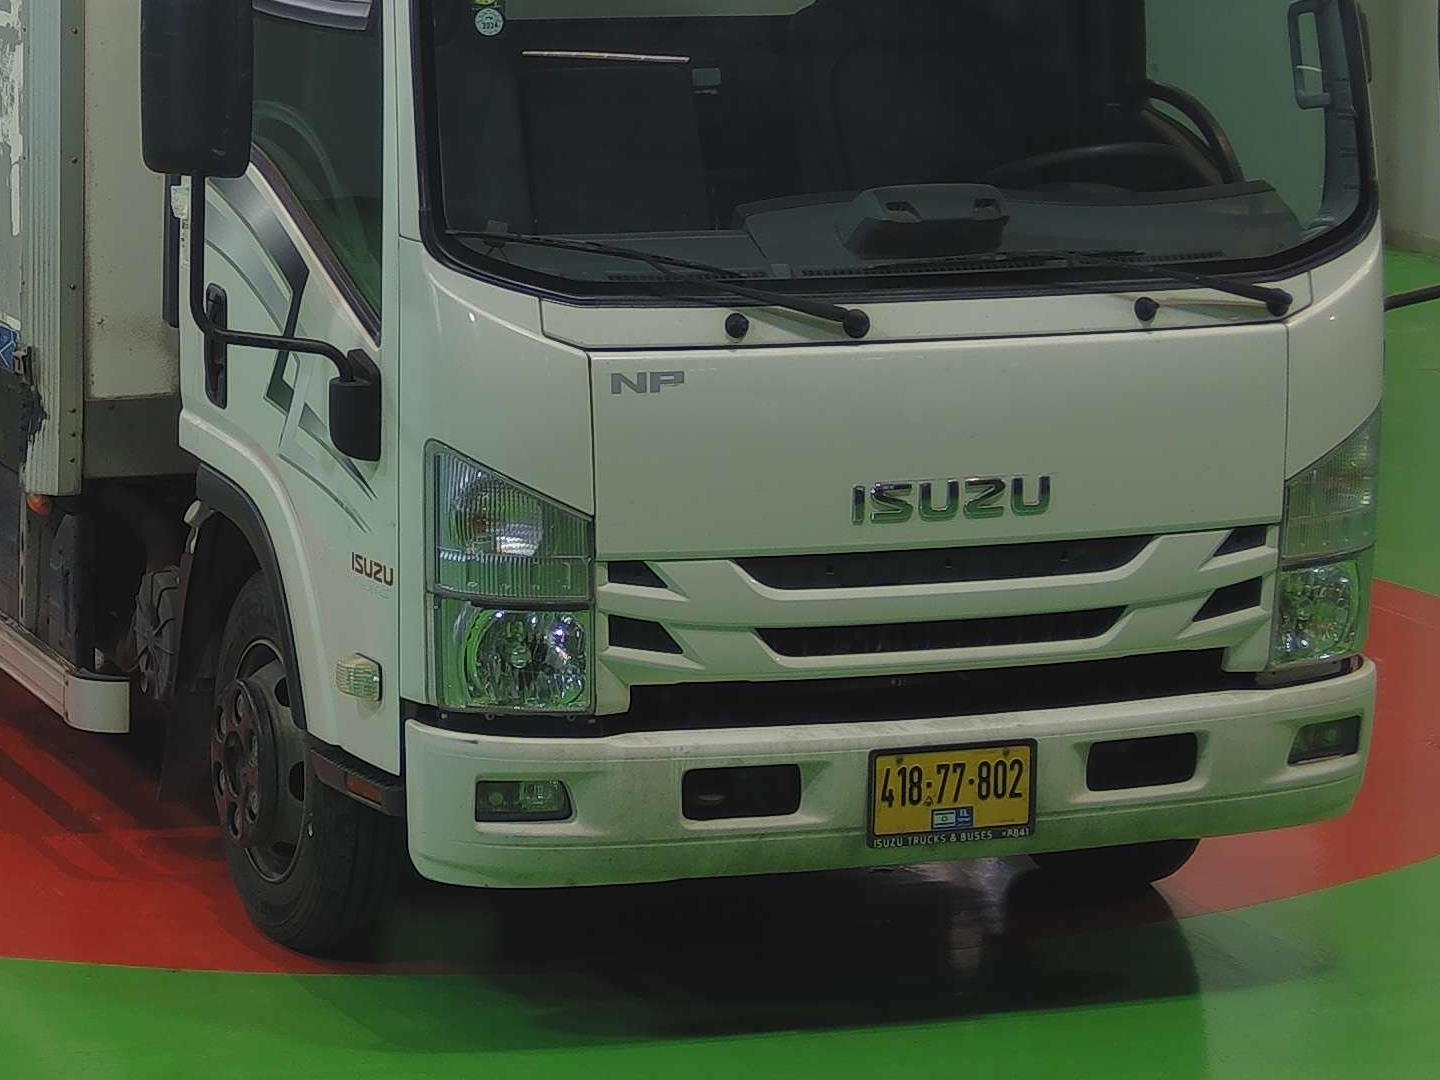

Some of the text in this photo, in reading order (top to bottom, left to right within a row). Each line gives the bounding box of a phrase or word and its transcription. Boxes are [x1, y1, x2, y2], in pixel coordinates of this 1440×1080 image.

[611, 371, 684, 394] NP
[851, 475, 1051, 526] ISUZU
[351, 551, 394, 587] ISUZU
[873, 836, 903, 848] ISUZU
[908, 833, 947, 844] TRUCKS
[950, 833, 957, 842] &
[961, 830, 993, 841] BUSES
